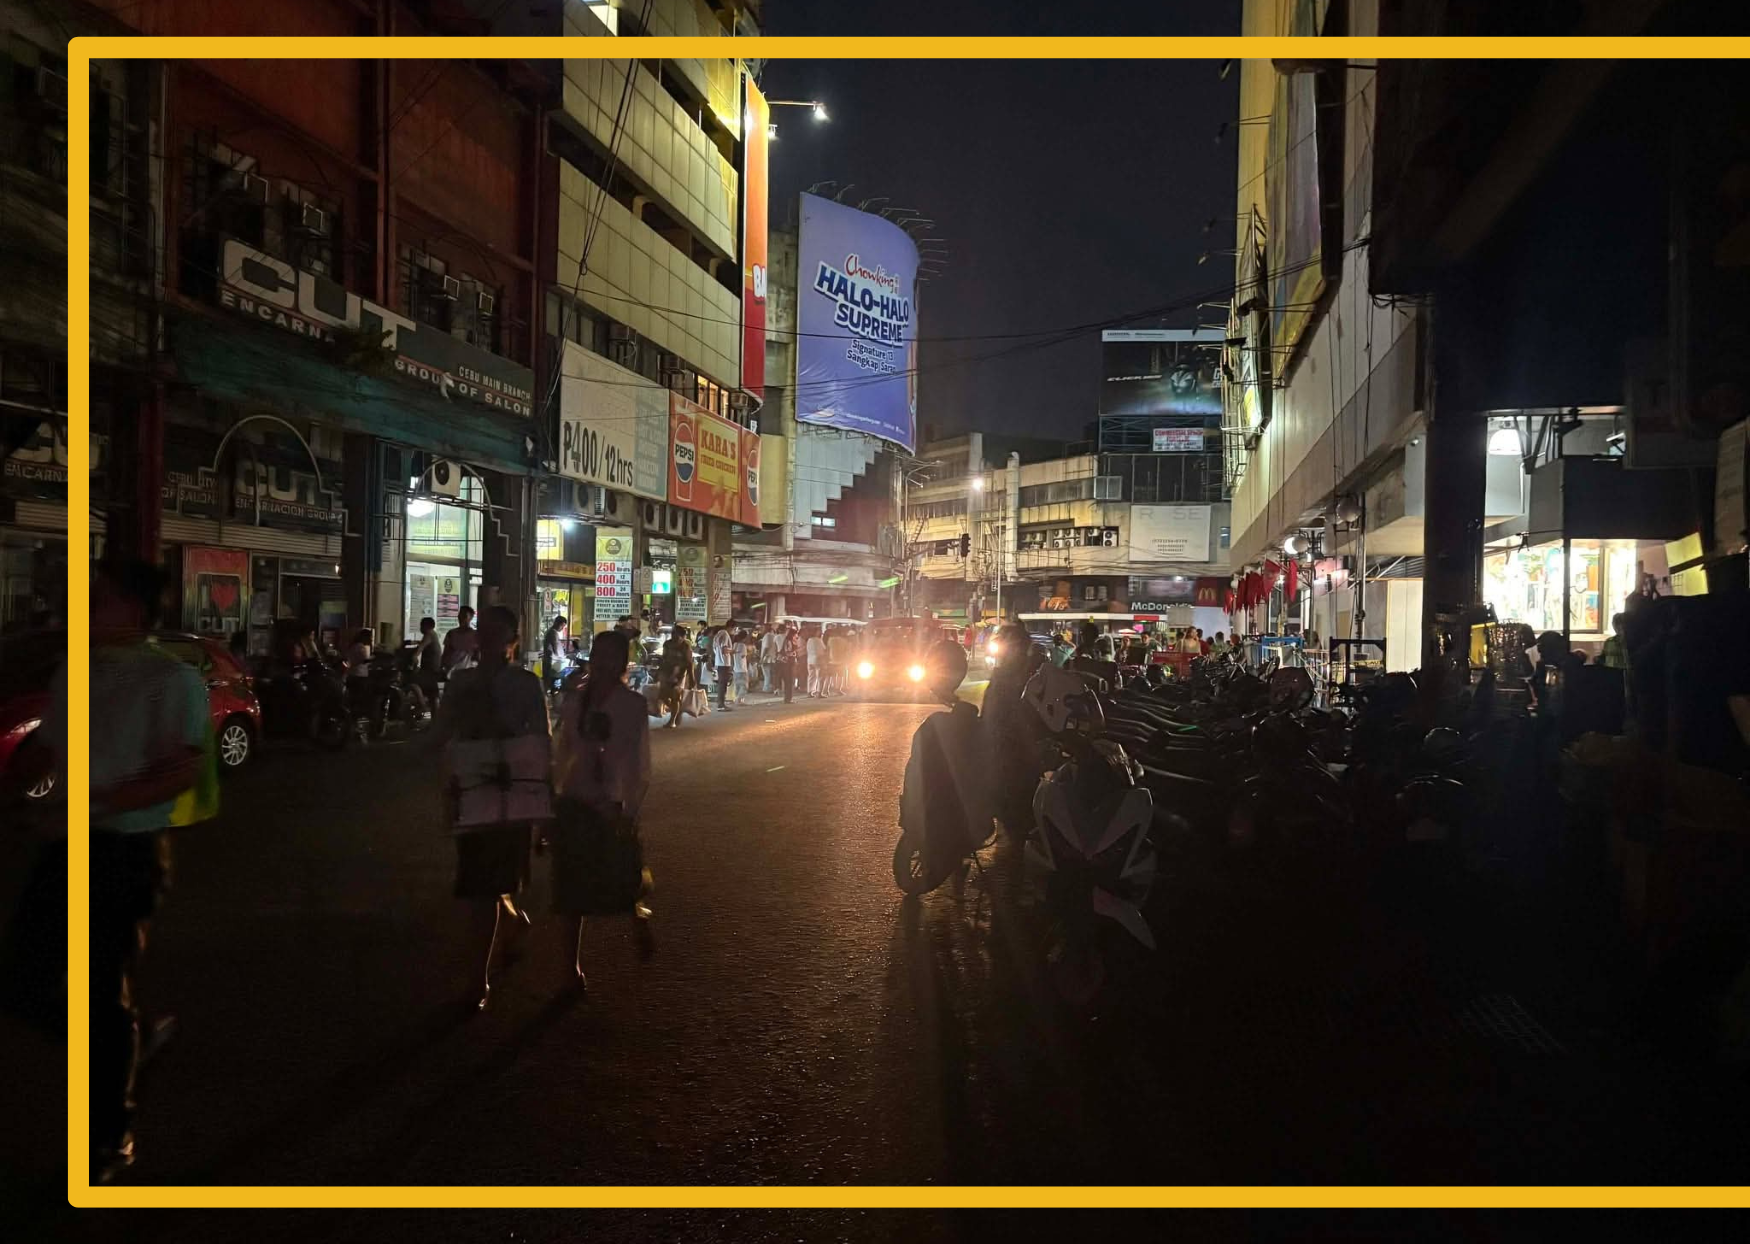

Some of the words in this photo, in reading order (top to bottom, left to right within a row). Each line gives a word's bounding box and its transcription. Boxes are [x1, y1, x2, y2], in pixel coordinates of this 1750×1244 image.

[845, 255, 894, 293] Chowking
[223, 238, 417, 351] CUT
[816, 264, 909, 322] HALO-HALO
[836, 303, 903, 343] SUPREME
[847, 349, 879, 371] Sangkap
[852, 339, 886, 360] Signature
[394, 360, 442, 384] GROU
[459, 382, 479, 398] OF
[484, 392, 531, 417] SALON
[458, 366, 481, 382] CEBU
[482, 375, 502, 391] MAIN
[503, 385, 532, 401] BRANCH
[675, 443, 694, 461] PEPSI
[701, 430, 736, 461] KARA'S
[4, 461, 68, 483] ENCARN
[597, 562, 615, 572] 250
[597, 575, 615, 584] 400
[597, 587, 615, 596] 800
